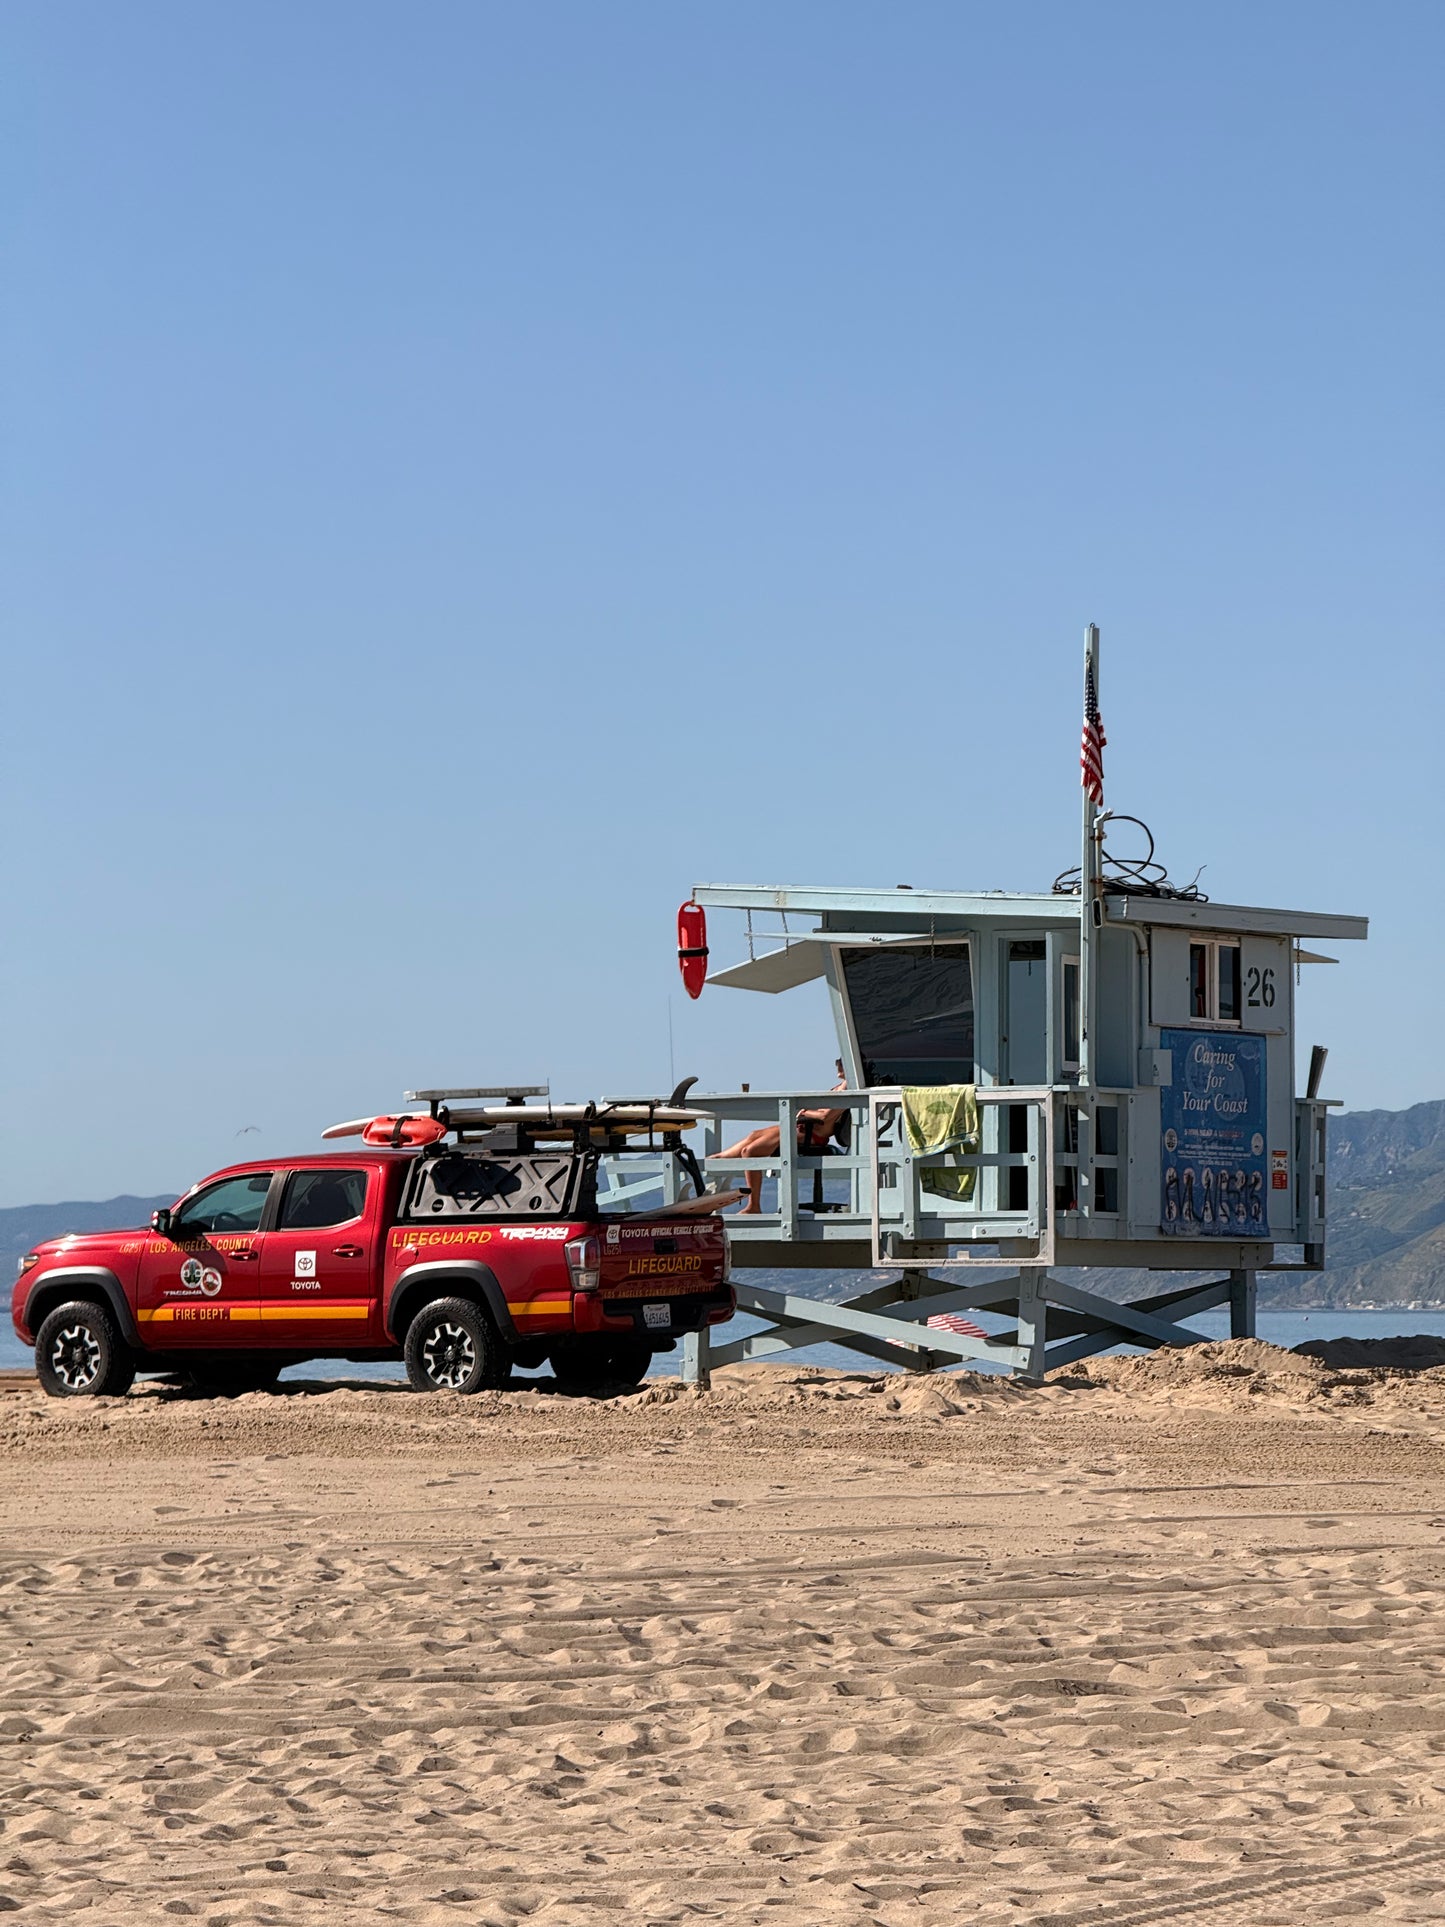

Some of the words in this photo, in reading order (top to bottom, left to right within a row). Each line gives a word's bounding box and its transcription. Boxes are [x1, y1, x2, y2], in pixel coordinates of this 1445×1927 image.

[1247, 966, 1276, 1008] 26
[1194, 1044, 1236, 1072] Caring
[1203, 1068, 1226, 1093] for
[1182, 1090, 1211, 1112] Your
[1213, 1093, 1249, 1114] Coast
[392, 1231, 493, 1248] LIFEGUARD
[621, 1228, 650, 1238] TOYOTA
[149, 1242, 167, 1254] LOS
[171, 1240, 212, 1253] ANGELES
[216, 1238, 256, 1251] COUNTY
[628, 1255, 702, 1274] LIFEGUARD
[290, 1281, 322, 1290] TOYOTA
[175, 1309, 197, 1320] FIRE
[200, 1308, 229, 1320] DEPT.
